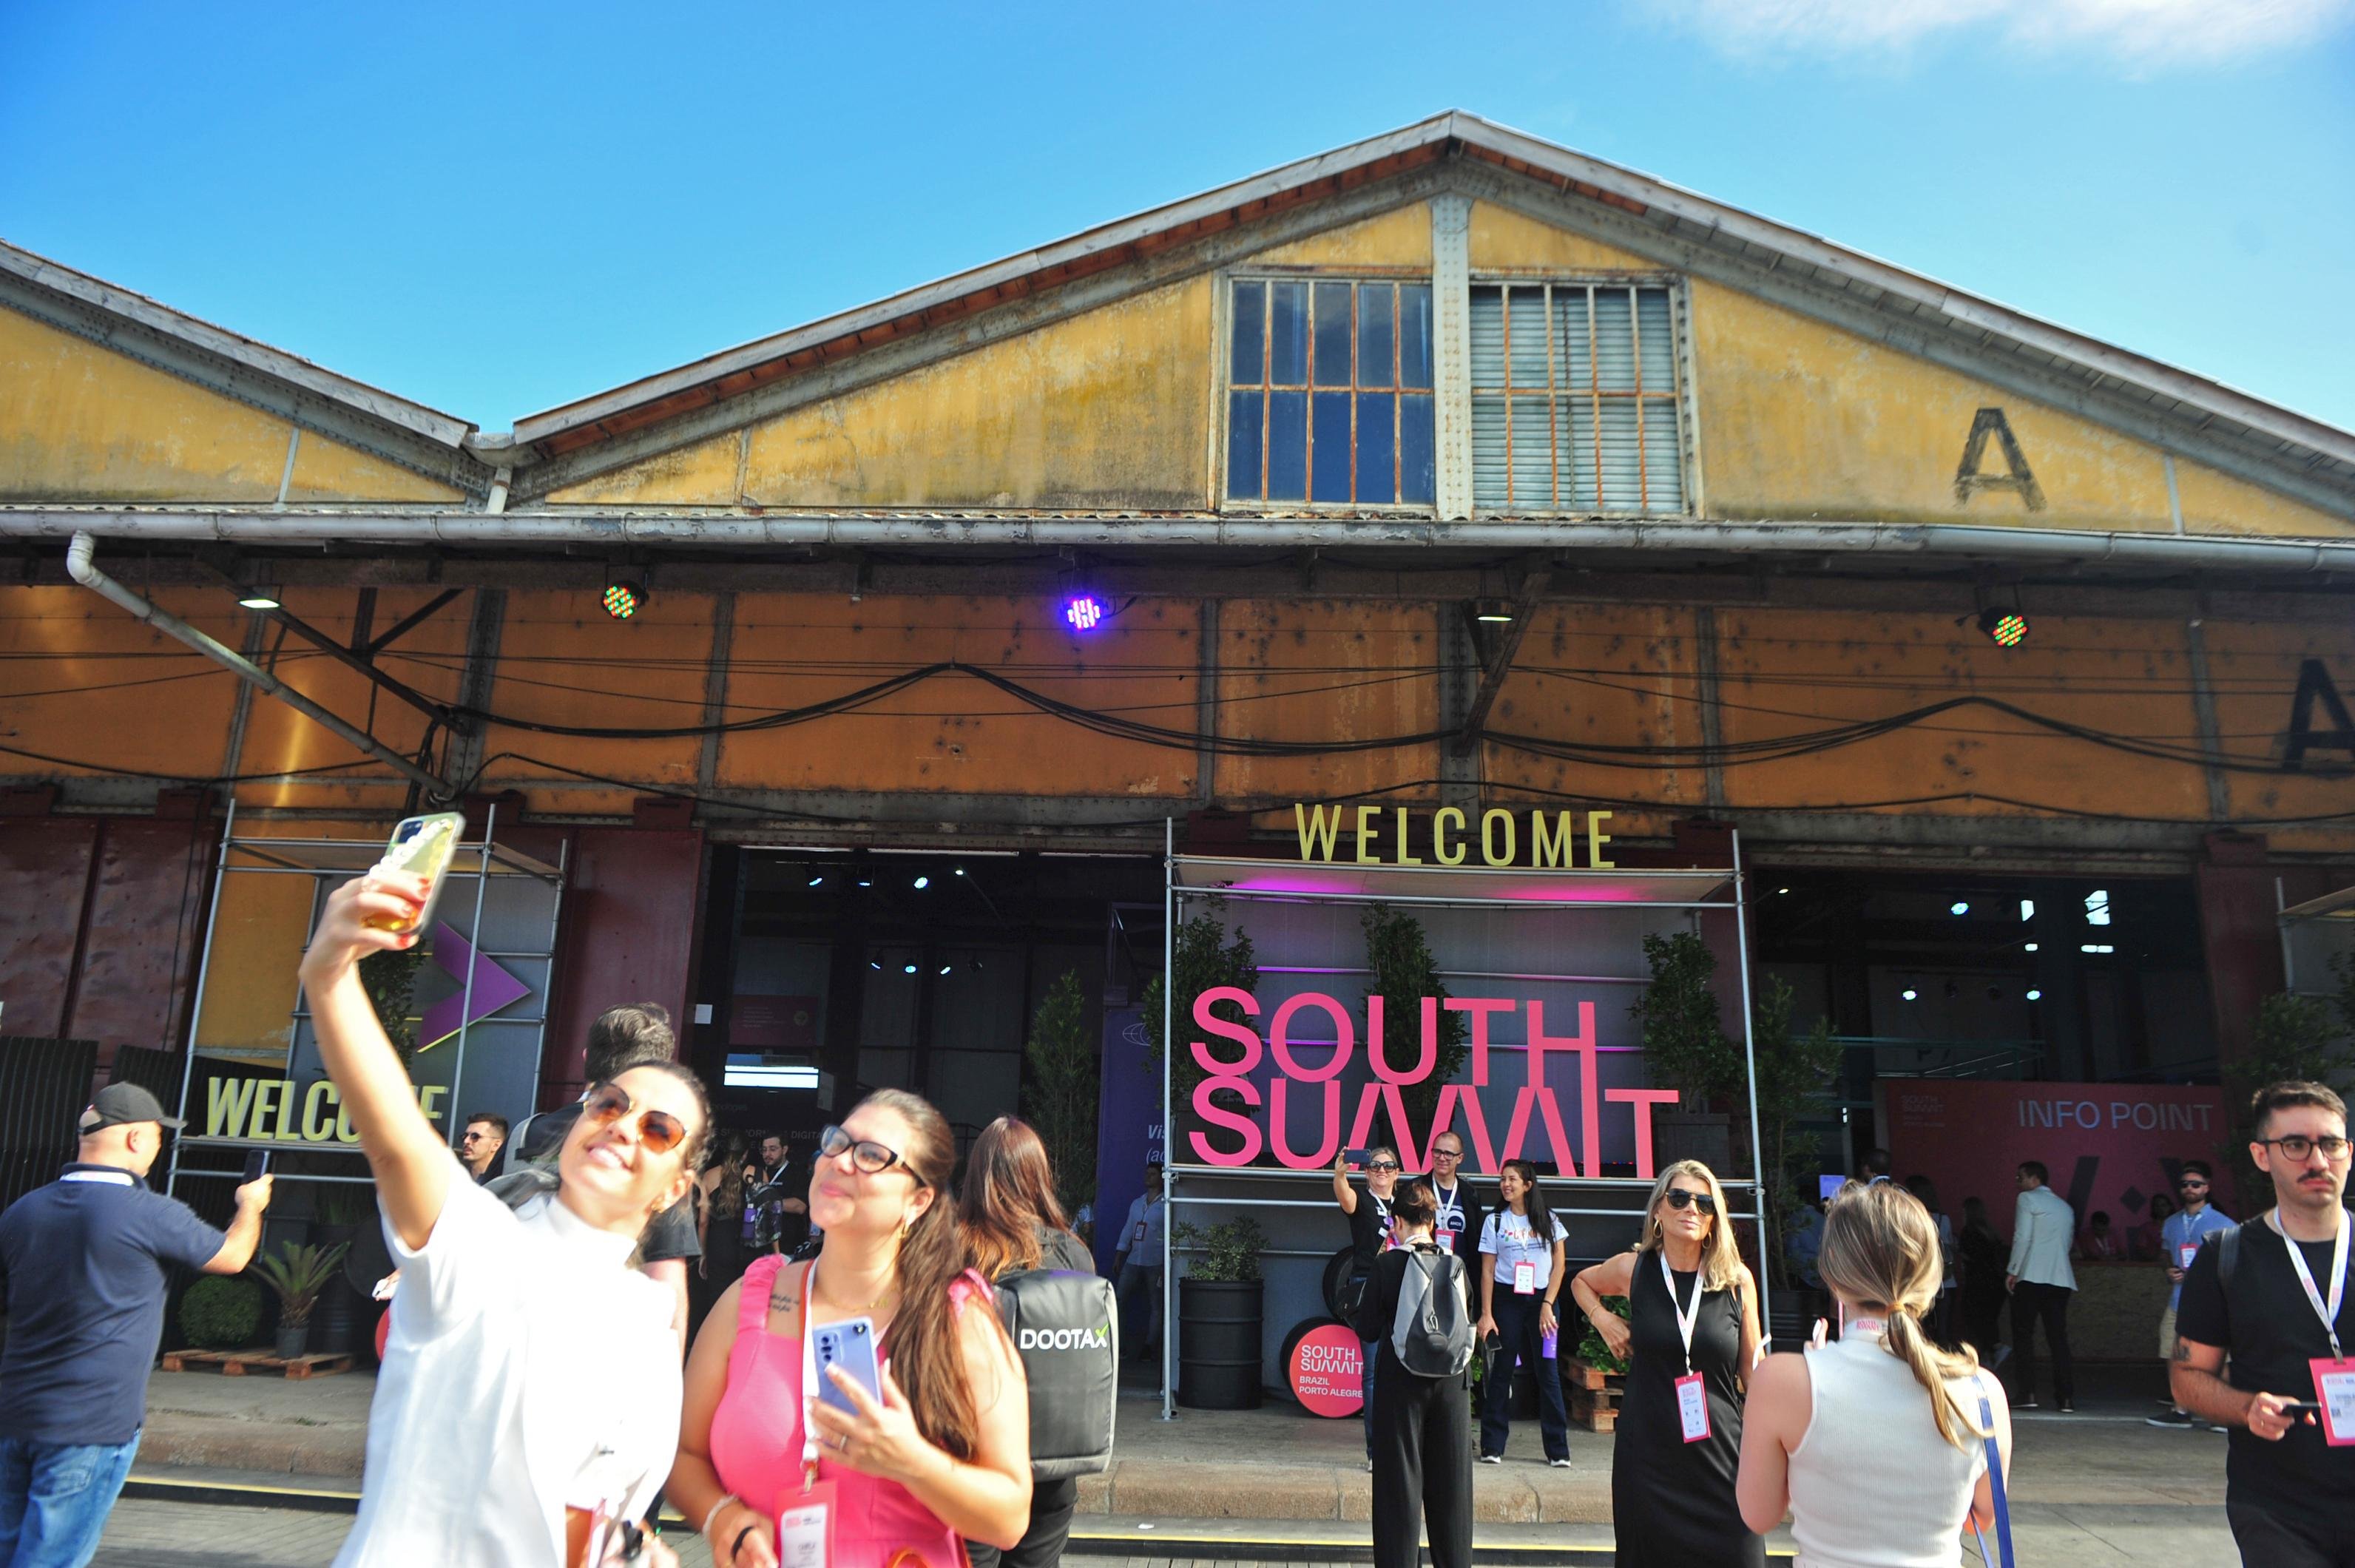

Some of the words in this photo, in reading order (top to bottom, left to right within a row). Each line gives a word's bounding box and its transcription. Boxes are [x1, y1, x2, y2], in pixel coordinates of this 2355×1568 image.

[1954, 408, 2047, 513] A
[1295, 803, 1615, 869] WELCOME
[1189, 986, 1598, 1088] SOUTH
[1189, 1075, 1679, 1178] SUMMIT
[2019, 1099, 2101, 1129] INFO
[2110, 1101, 2214, 1132] POINT
[1020, 1322, 1109, 1350] DOOTAX
[1300, 1358, 1363, 1375] SUMMIT
[1301, 1345, 1355, 1361] SOUTH
[1299, 1386, 1328, 1396] PORTO
[1330, 1388, 1363, 1398] ALEGRE
[1300, 1376, 1330, 1385] BRAZIL
